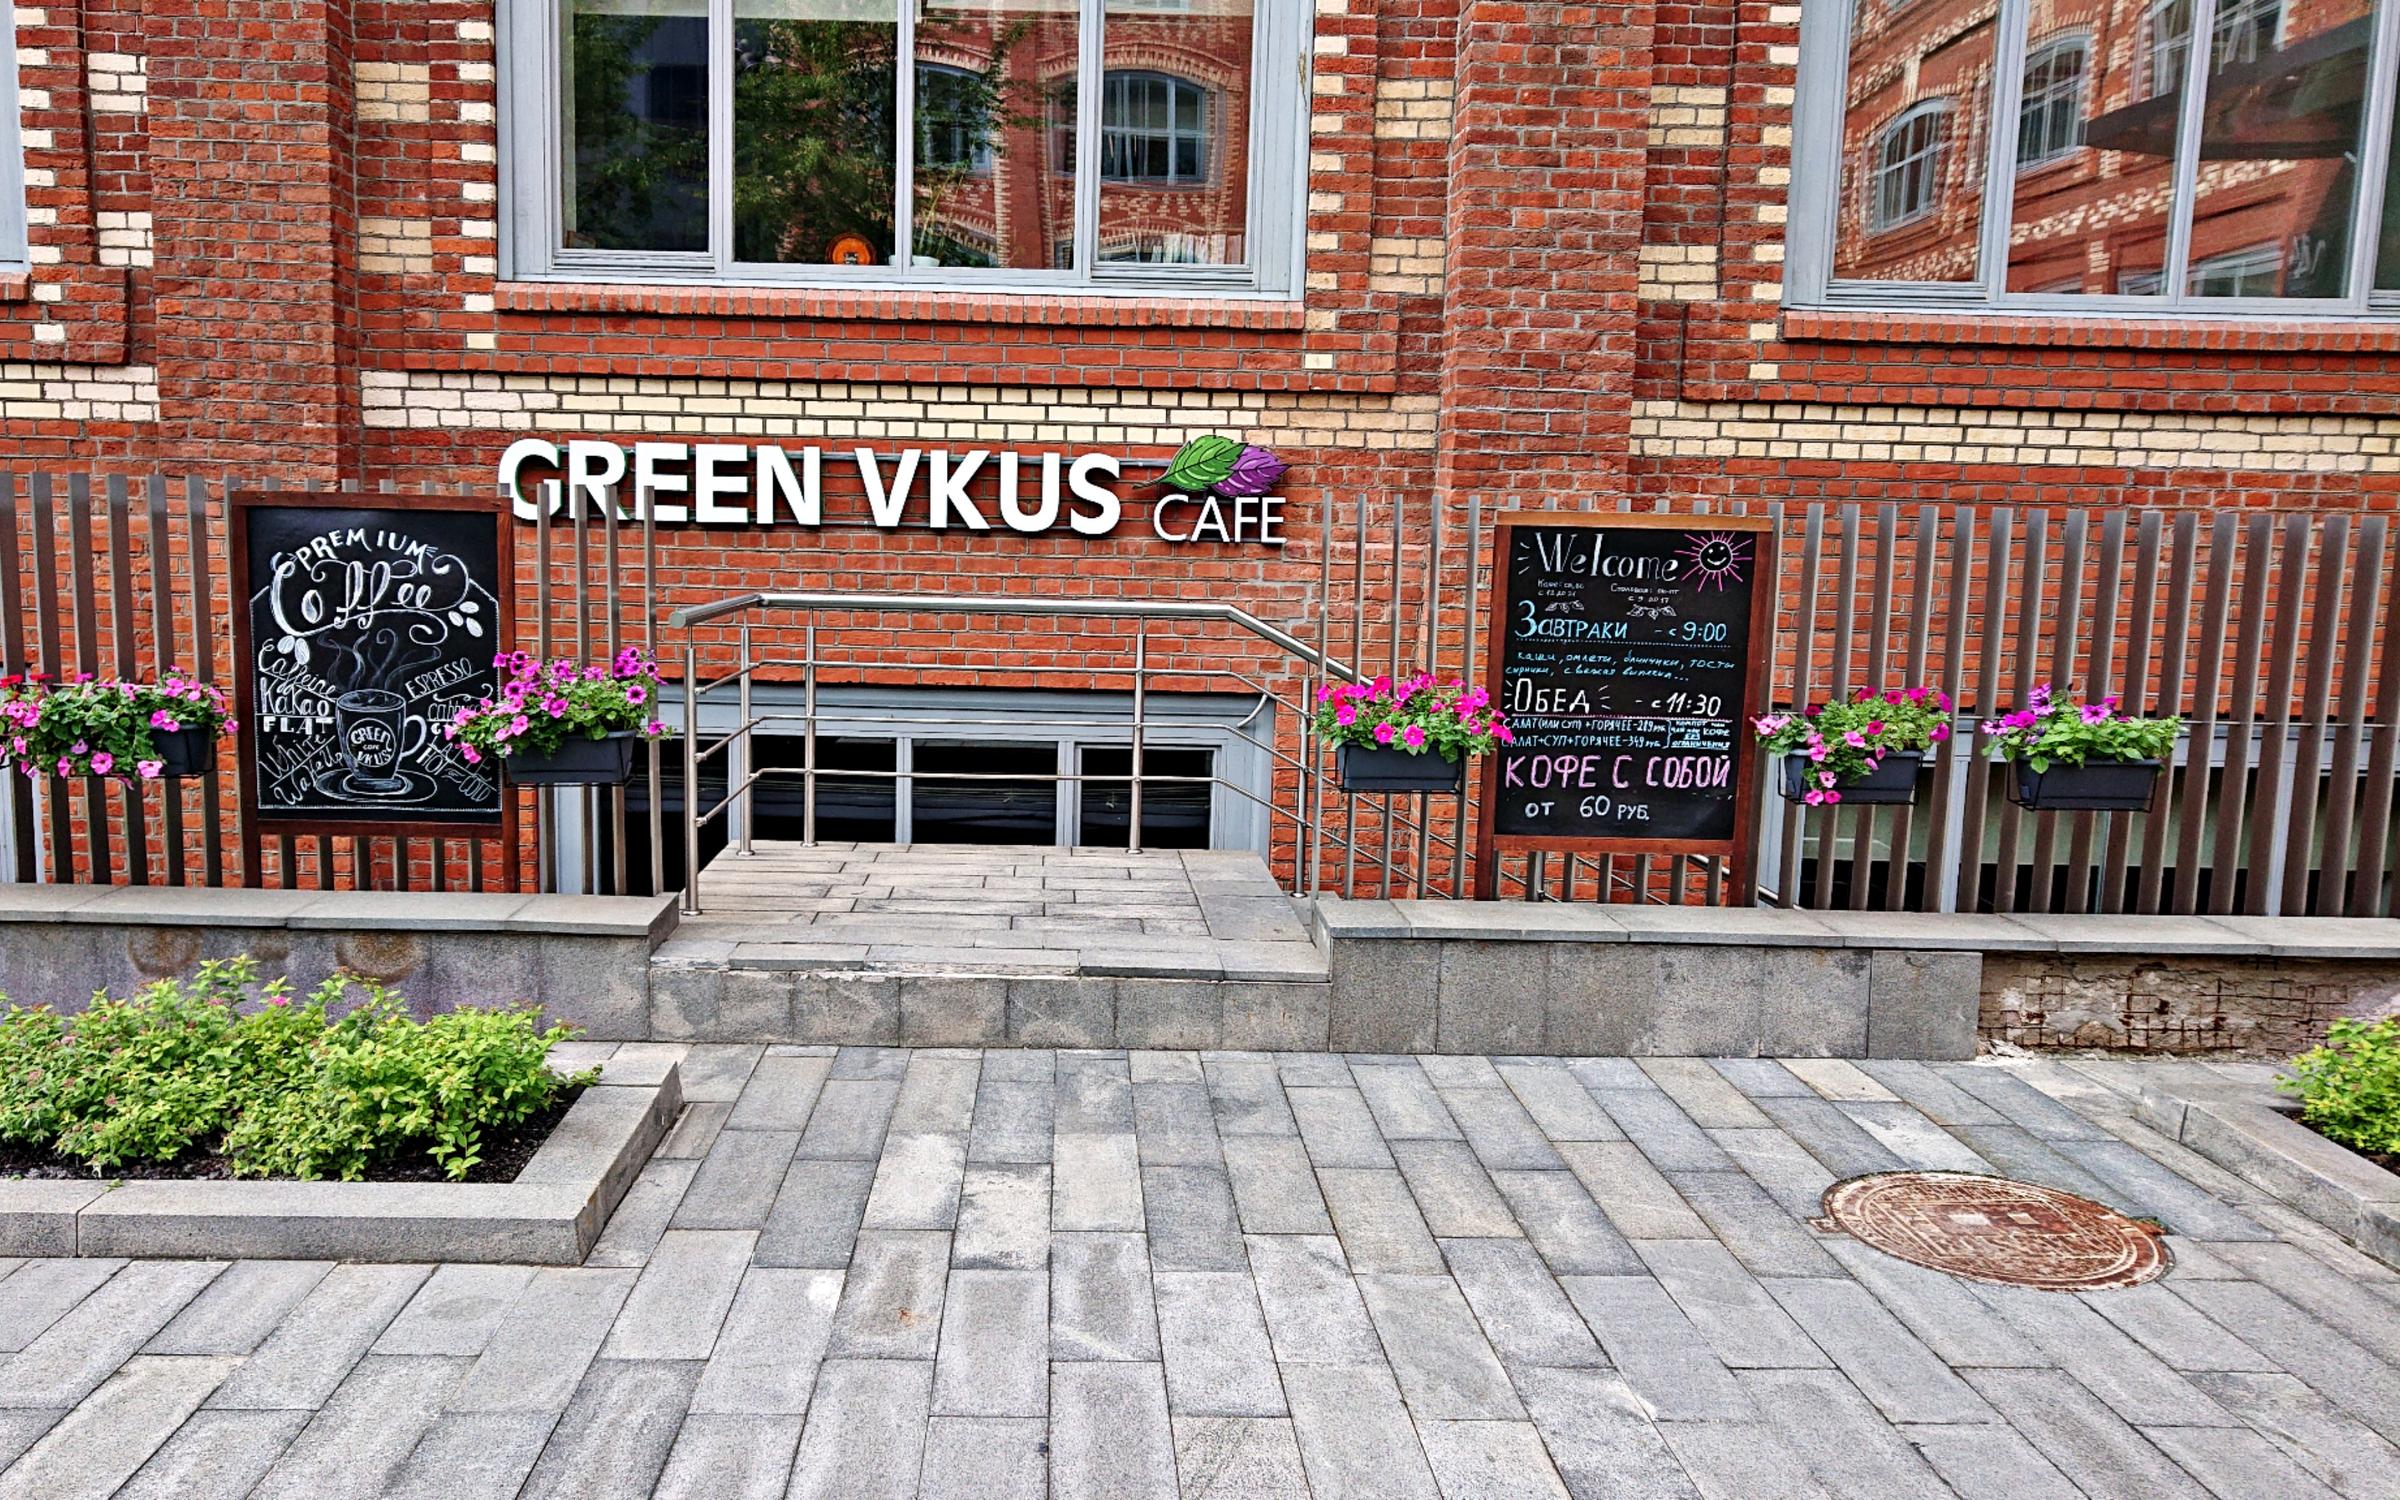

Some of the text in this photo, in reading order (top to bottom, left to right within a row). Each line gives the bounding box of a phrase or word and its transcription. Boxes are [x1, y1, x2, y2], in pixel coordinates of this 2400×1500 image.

[498, 438, 1121, 536] GREEN VKUS
[1152, 493, 1287, 545] CAFE
[295, 527, 432, 574] PREMIUM
[1534, 531, 1679, 582] Welcome
[270, 552, 470, 637] Coffee
[1682, 621, 1727, 642] 9:00
[405, 657, 473, 699] ESPRESSO
[1666, 691, 1722, 717] 11:30
[263, 715, 334, 735] FLAT
[1703, 727, 1731, 737] КОФЕ
[1505, 754, 1731, 789] КОФЕ С СОБОЙ
[1580, 795, 1611, 817] 60
